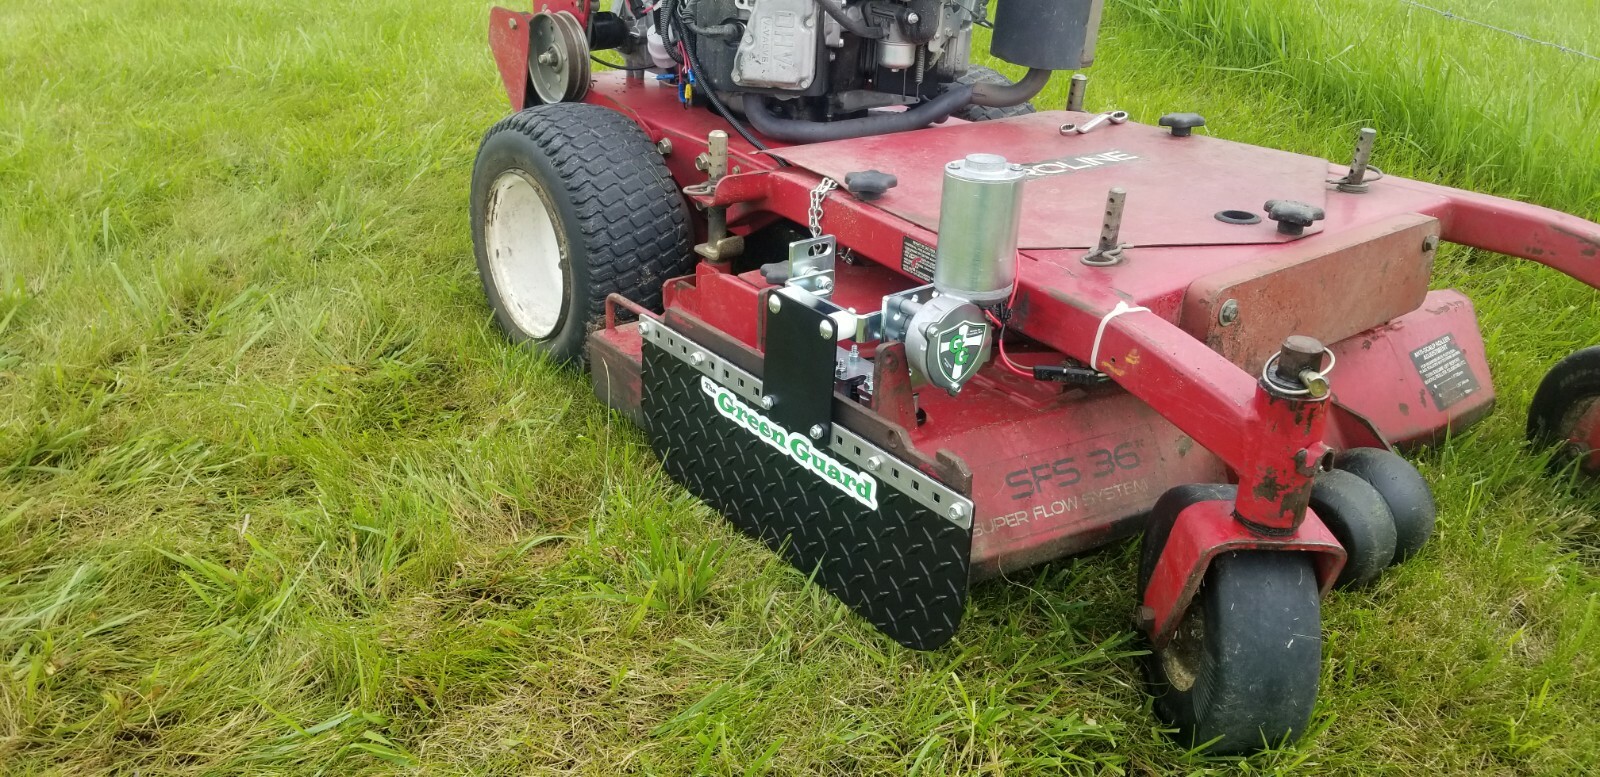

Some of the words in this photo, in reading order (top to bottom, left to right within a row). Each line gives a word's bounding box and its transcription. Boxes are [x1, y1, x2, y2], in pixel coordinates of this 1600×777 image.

[717, 392, 787, 449] Green
[789, 438, 874, 501] Guard
[1004, 457, 1082, 500] SFS
[972, 511, 1029, 538] SUPER
[1032, 496, 1078, 520] FLOW
[1081, 480, 1149, 507] SYSTEM
